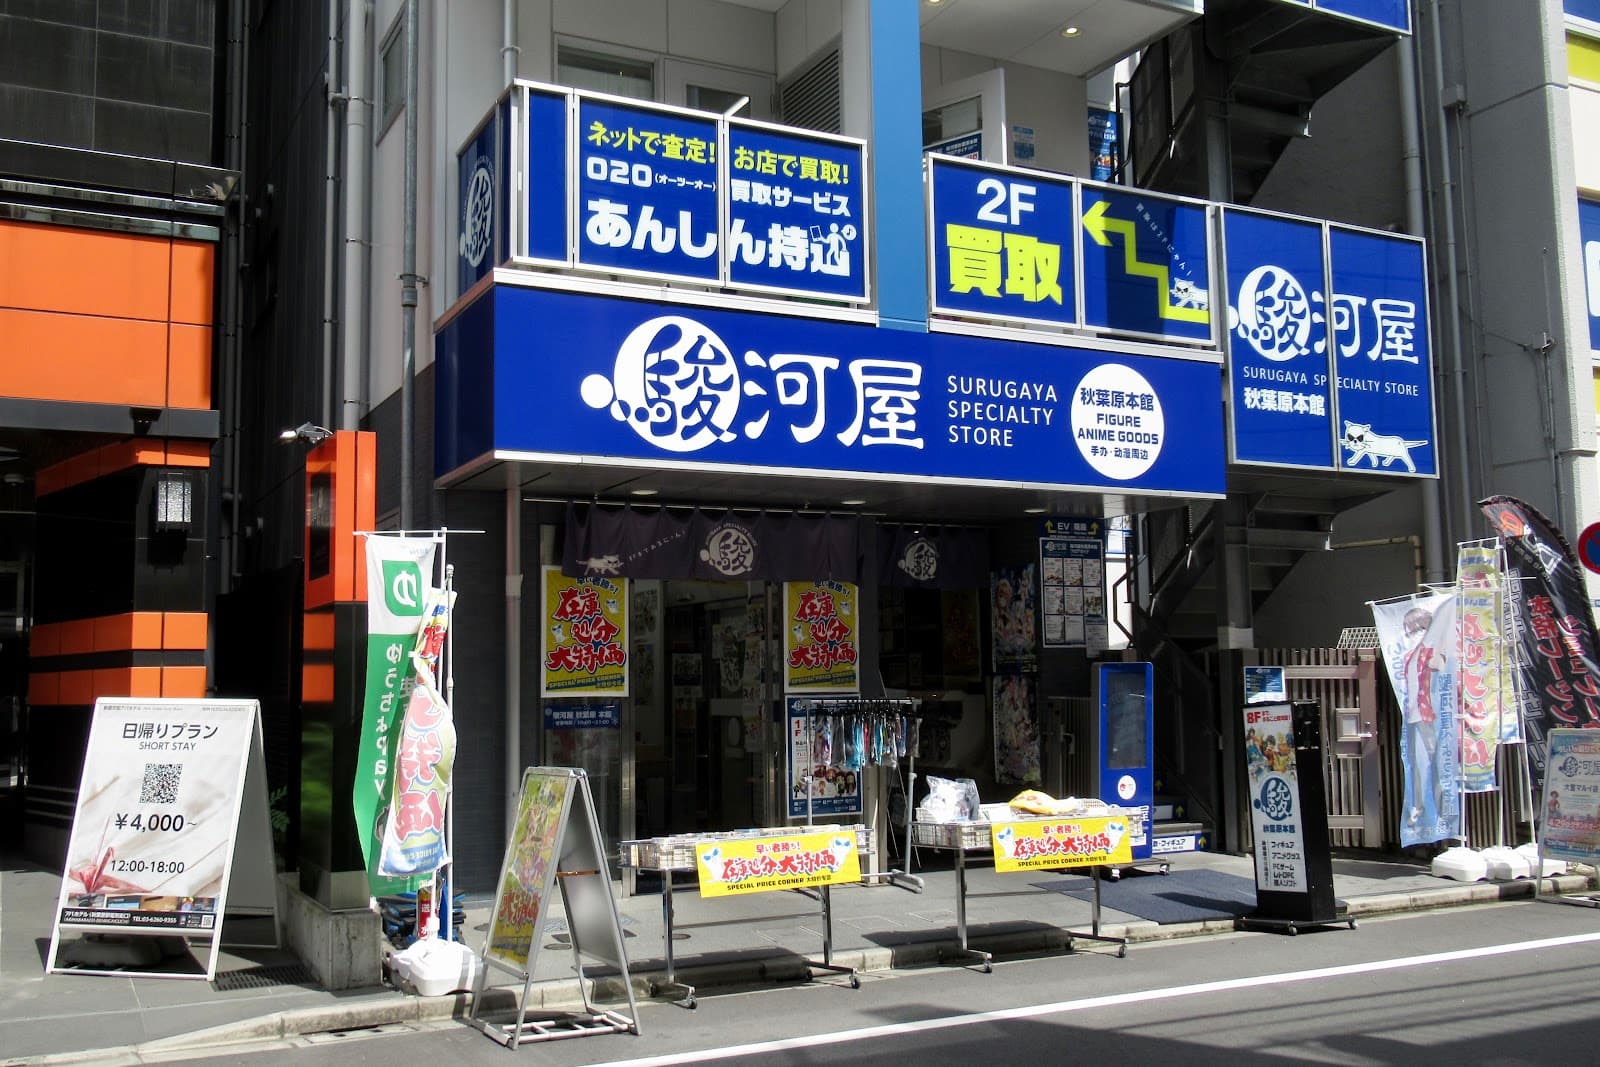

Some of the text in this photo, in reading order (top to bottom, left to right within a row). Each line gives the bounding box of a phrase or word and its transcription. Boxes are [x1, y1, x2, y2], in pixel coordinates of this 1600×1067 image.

[587, 121, 849, 185] ネットで査定! お店で買取!
[730, 179, 851, 218] 買取サービス
[975, 178, 1037, 226] 2F
[946, 223, 1062, 304] 買取
[608, 315, 924, 453] 駿河屋
[948, 375, 1057, 403] SURUGAYA
[1243, 366, 1419, 396] SURUGAYA SPECIALTY STORE
[948, 400, 1054, 426] SPECIALTY
[1080, 387, 1154, 412] 秋葉原本館
[1243, 386, 1326, 416] 秋葉原本館
[1096, 413, 1141, 428] FIGURE
[948, 425, 1013, 448] STORE
[1077, 427, 1159, 445] ANIME GOODS
[1057, 522, 1070, 531] EV
[553, 587, 602, 621] 在庫
[795, 590, 836, 622] 在庫
[571, 615, 620, 645] 処分
[809, 616, 852, 645] 処分
[545, 642, 626, 674] 大特価
[787, 642, 858, 672] 大特価
[122, 722, 219, 740] 日帰りプラン
[1247, 711, 1261, 724] 8F
[139, 741, 197, 751] SHORT STAY
[756, 841, 801, 854] 早い者勝ち!
[1013, 832, 1111, 858] 在庫処分大特価
[110, 859, 186, 874] 12:00-18:00
[721, 849, 837, 881] 在庫処分大特価
[727, 883, 755, 891] SPECIAL
[757, 880, 776, 888] PRICE
[778, 877, 804, 886] CORNER
